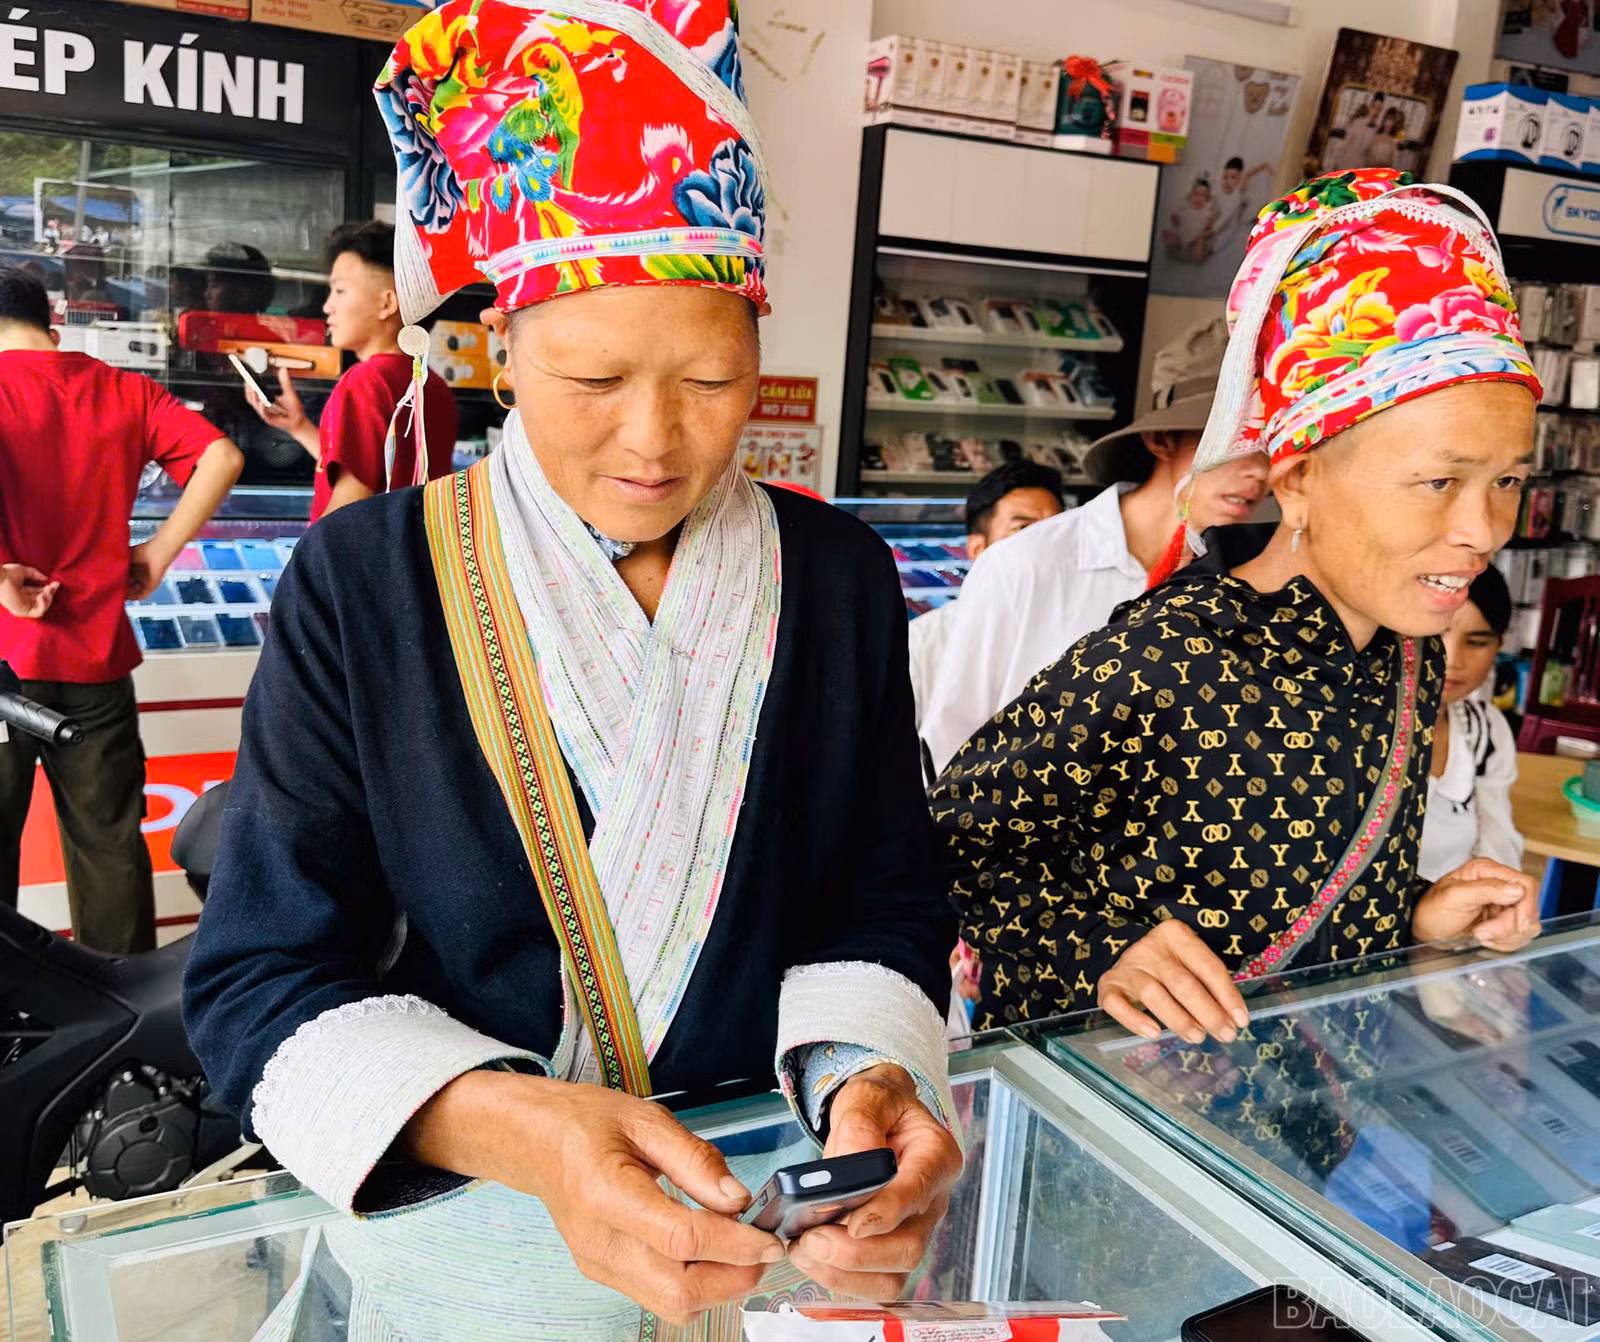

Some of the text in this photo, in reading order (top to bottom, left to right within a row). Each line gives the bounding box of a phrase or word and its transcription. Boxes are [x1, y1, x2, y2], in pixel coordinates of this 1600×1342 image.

[0, 7, 304, 124] ÉP KÍNH
[761, 403, 809, 417] NO FIRE
